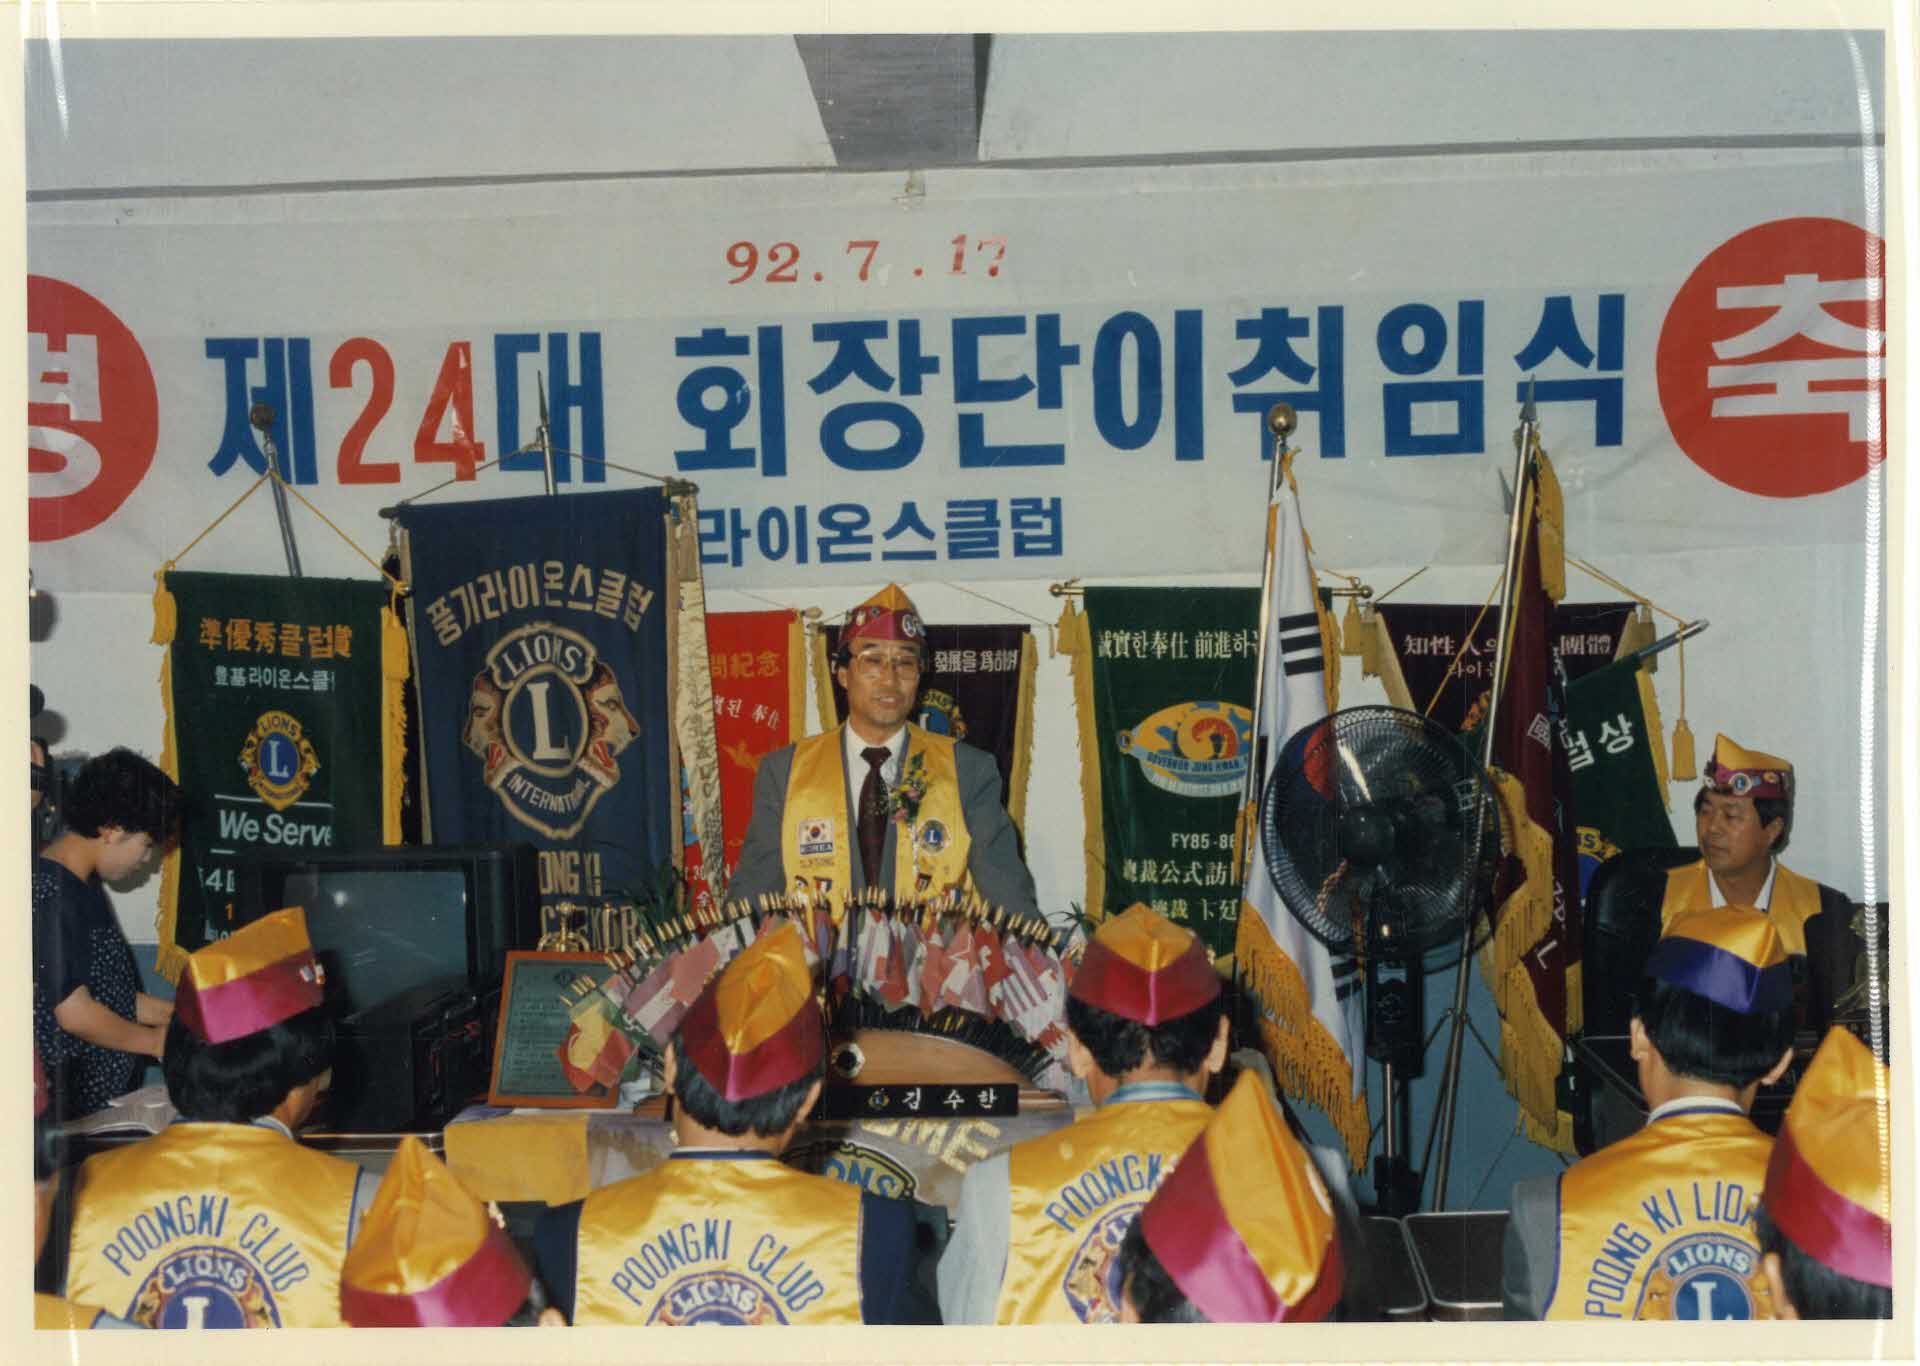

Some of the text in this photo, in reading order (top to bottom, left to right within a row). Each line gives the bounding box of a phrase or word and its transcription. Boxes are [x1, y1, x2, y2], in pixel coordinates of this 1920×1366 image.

[206, 331, 607, 487] 제24대
[700, 497, 1064, 568] 라이온스클럽
[426, 559, 655, 648] 풍기라이온스클럽
[503, 634, 583, 678] LIONS
[526, 680, 573, 760] L
[267, 739, 289, 778] L
[218, 808, 261, 841] We
[102, 1195, 310, 1292] POONGKI CLUB
[164, 1255, 248, 1291] LIONS
[611, 1218, 825, 1313] POONGKI CLUB
[1584, 1223, 1653, 1319] POONG
[1641, 1187, 1684, 1235] KI
[1668, 1244, 1750, 1276] LIONS
[670, 1280, 758, 1315] LIONS
